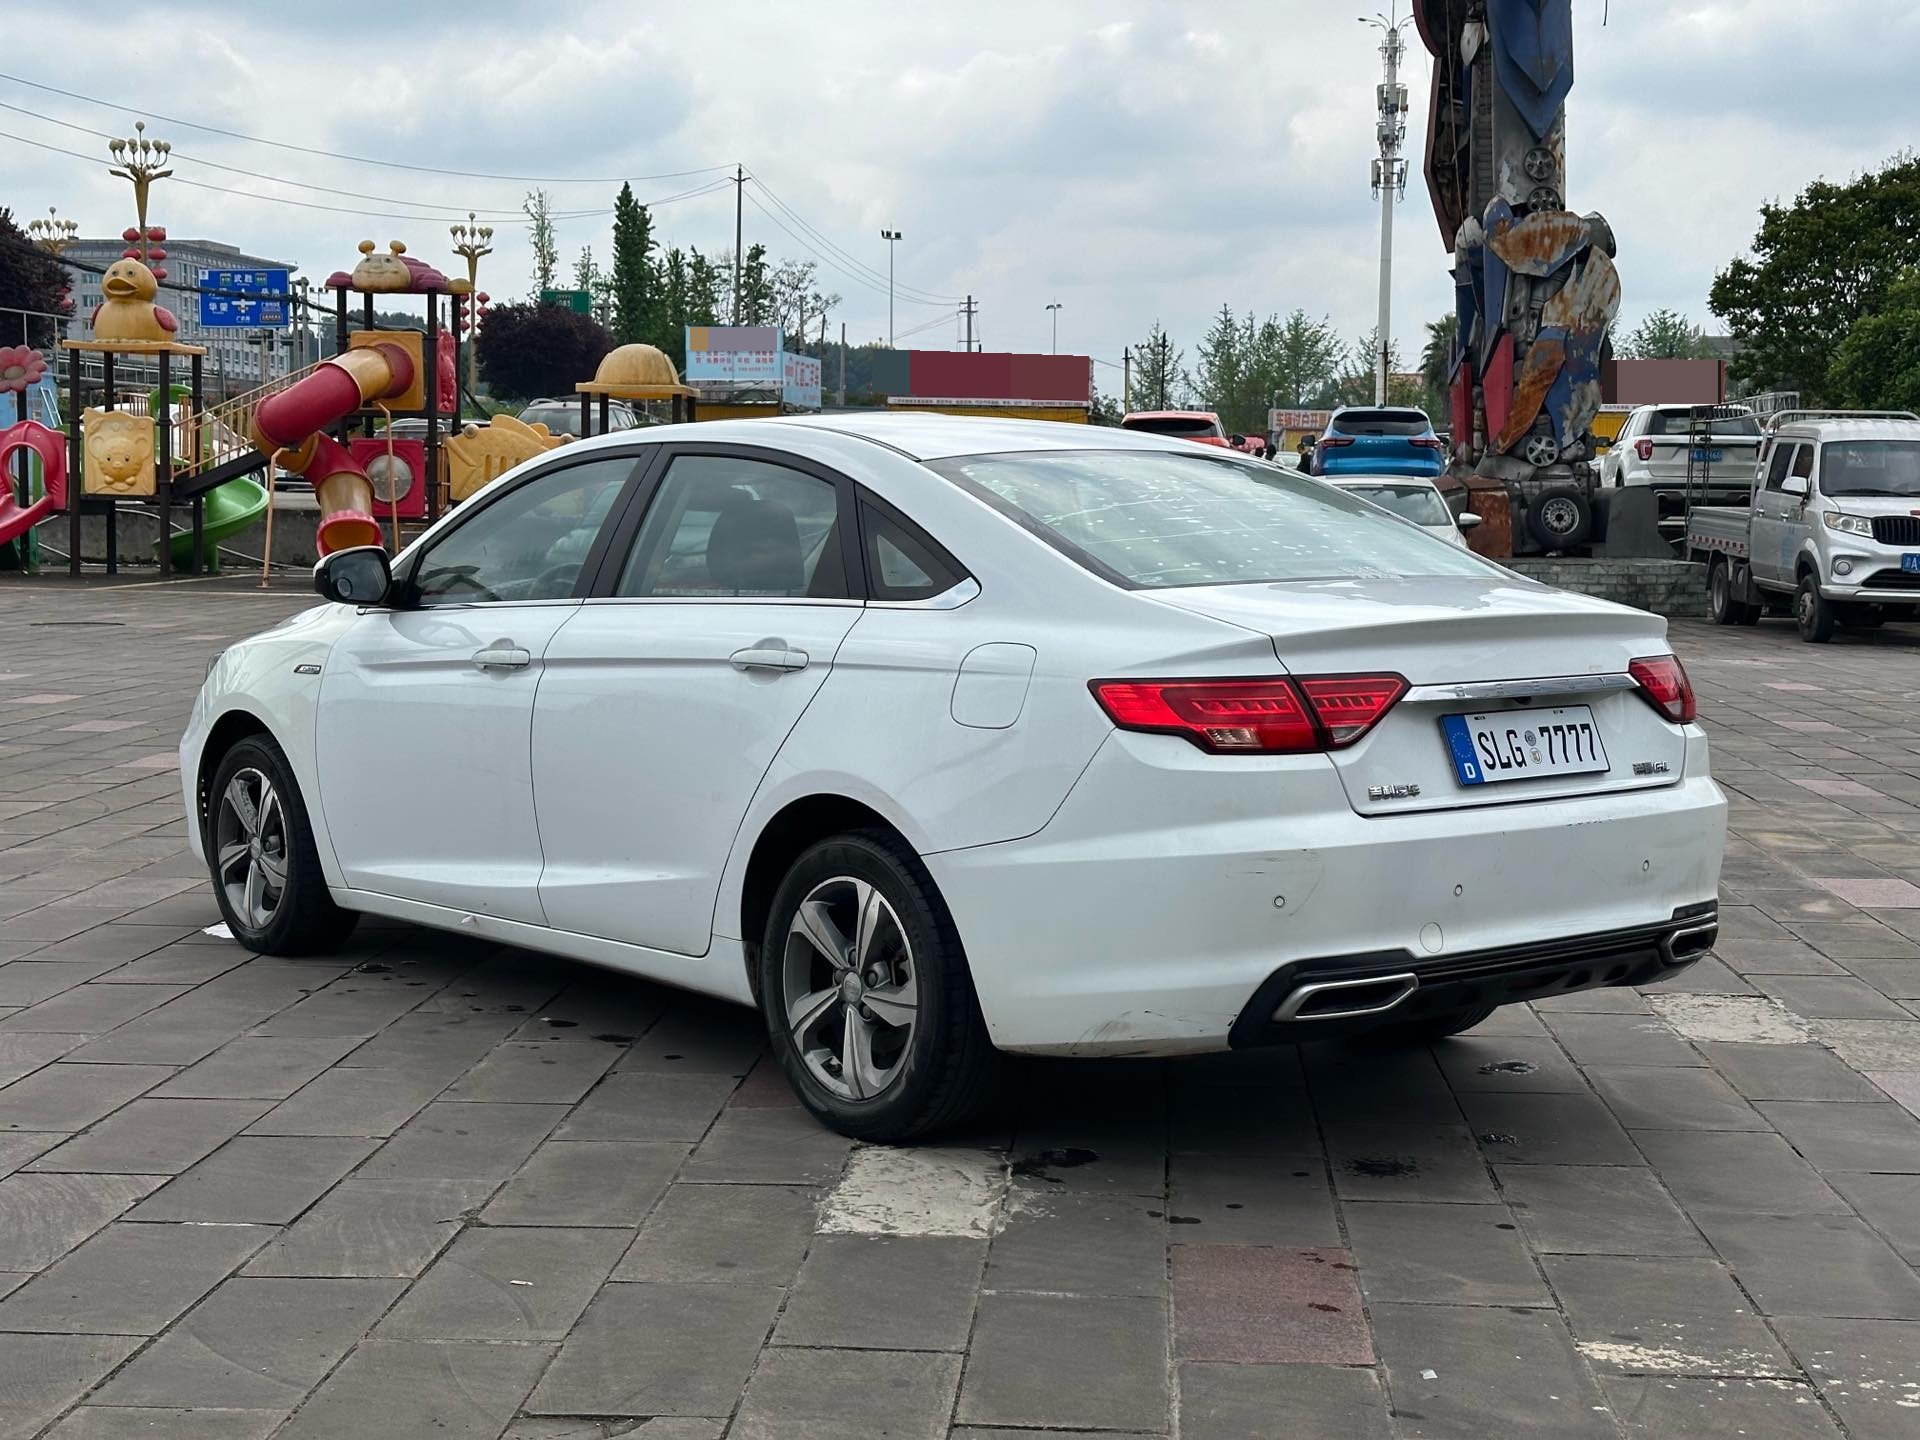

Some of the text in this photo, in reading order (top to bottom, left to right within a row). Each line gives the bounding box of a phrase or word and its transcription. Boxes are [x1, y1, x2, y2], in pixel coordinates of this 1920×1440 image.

[1464, 723, 1596, 779] D SLG 7777
